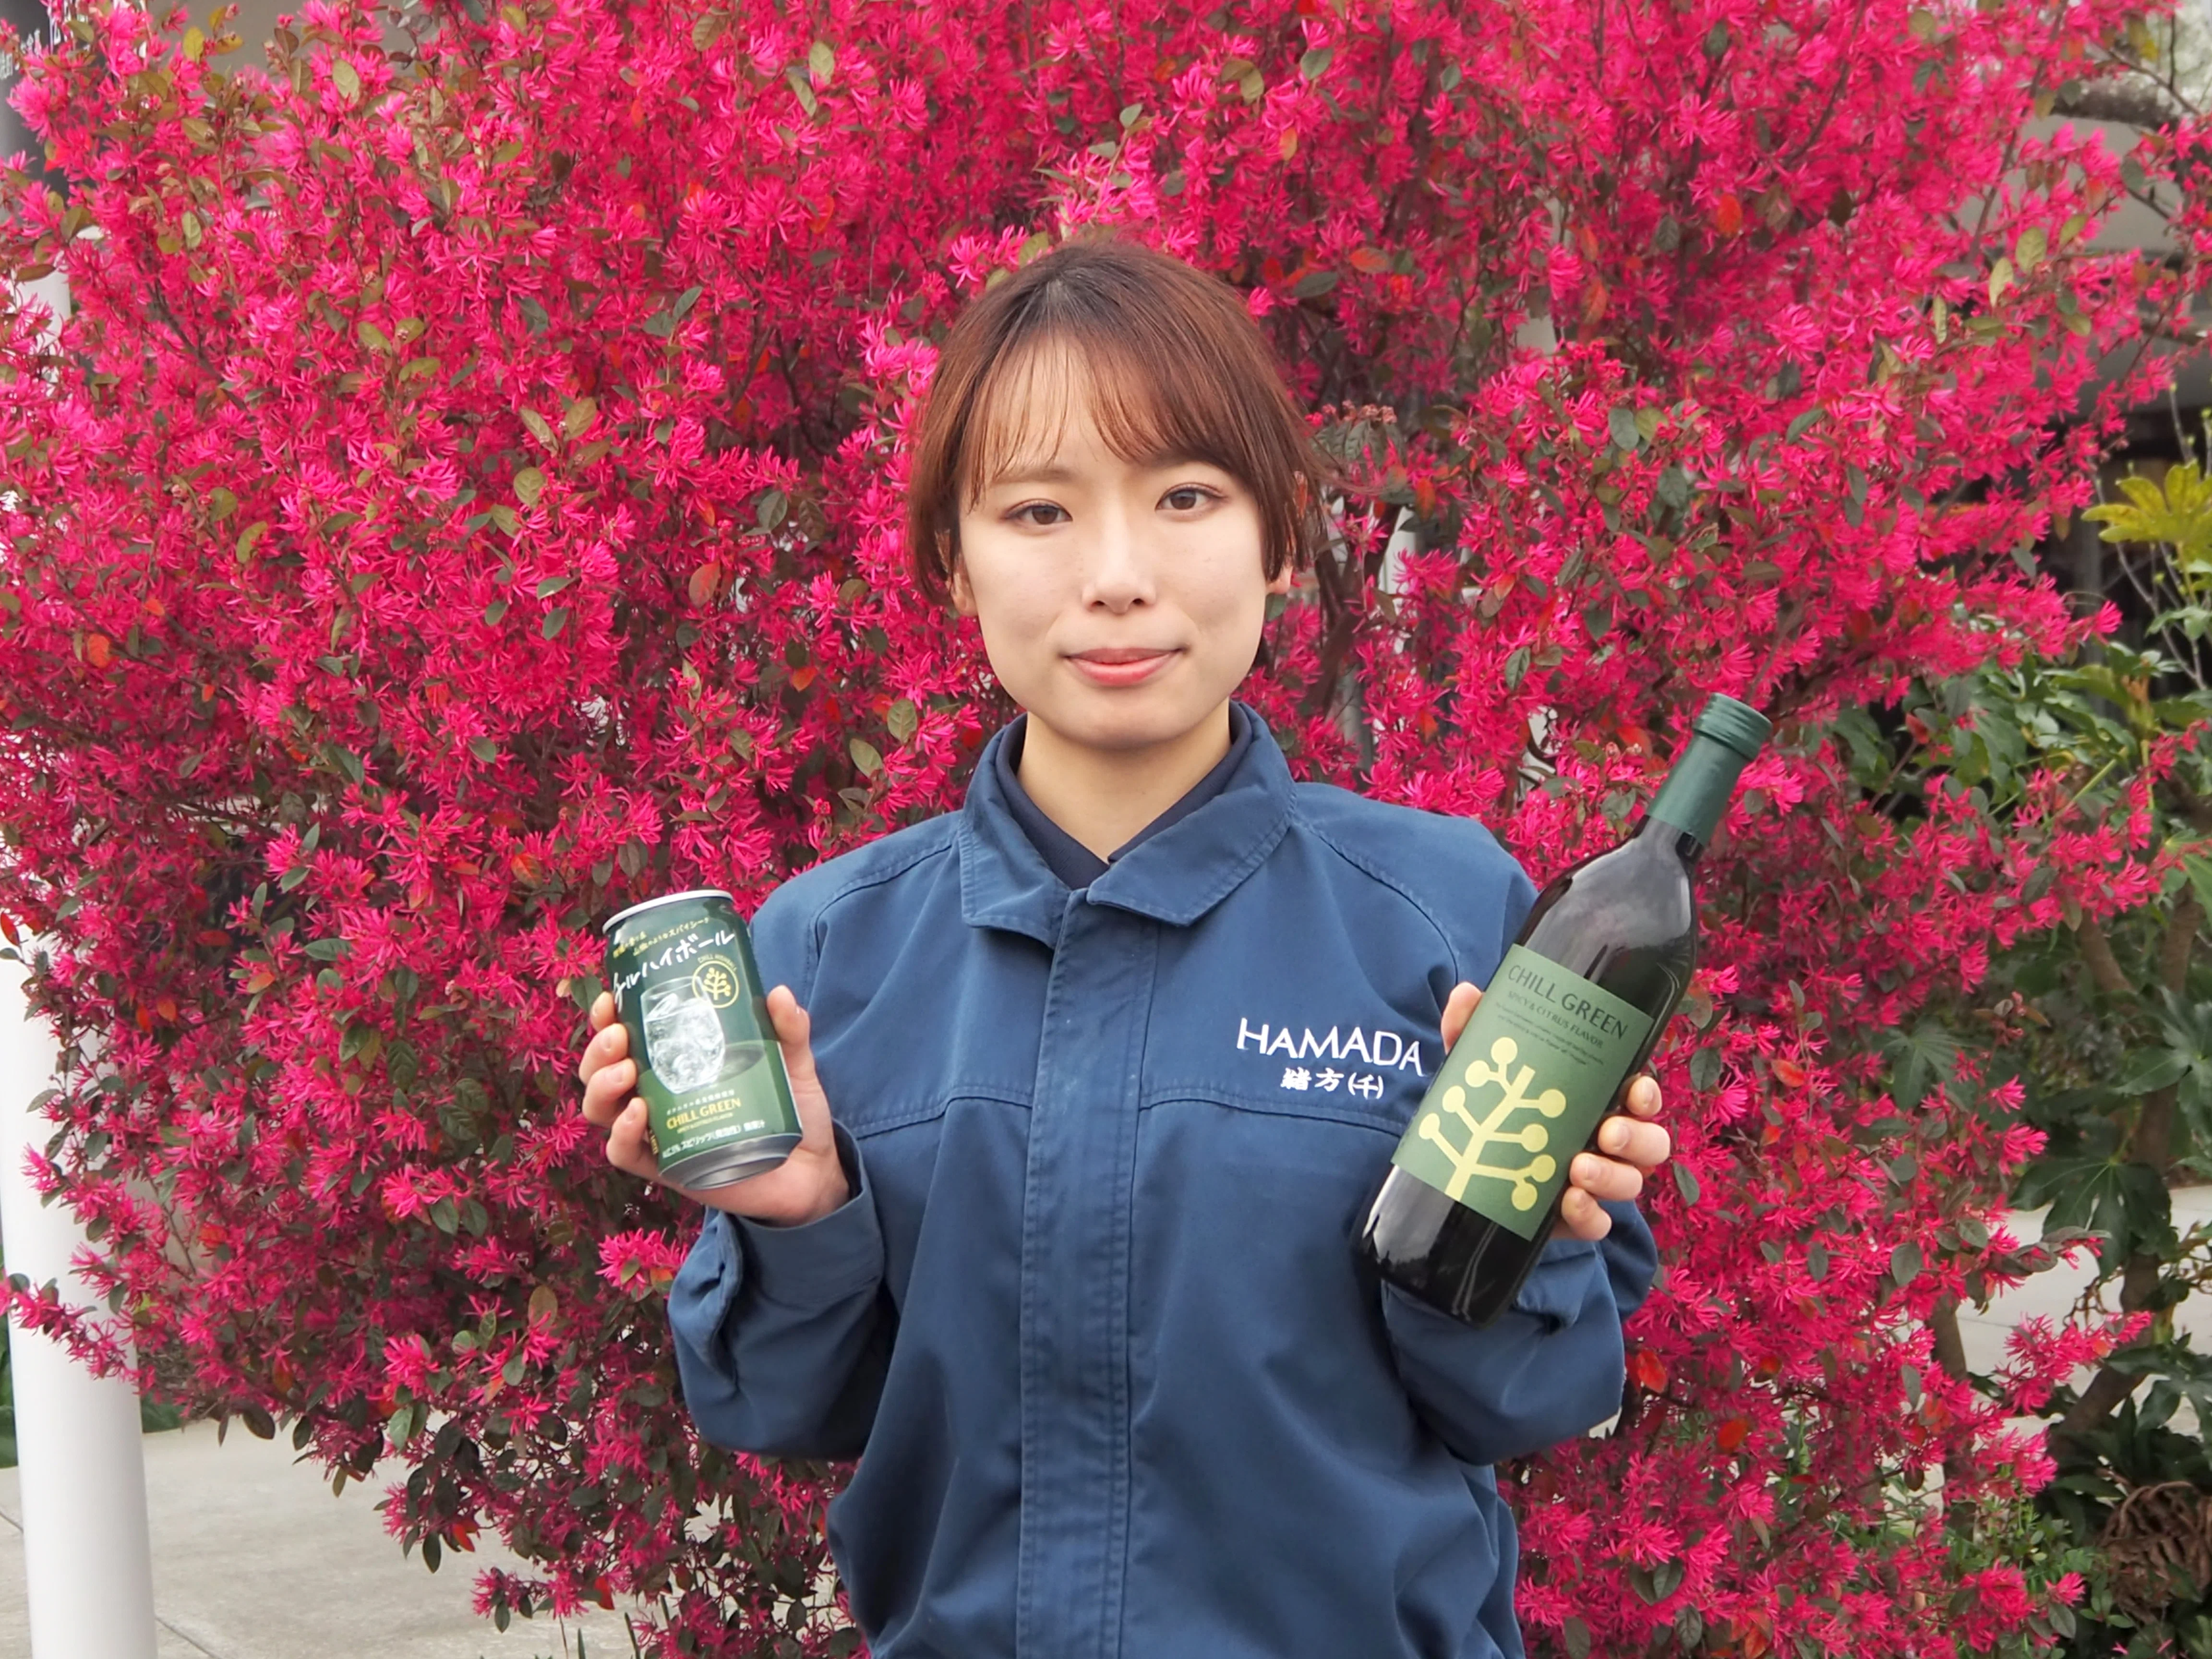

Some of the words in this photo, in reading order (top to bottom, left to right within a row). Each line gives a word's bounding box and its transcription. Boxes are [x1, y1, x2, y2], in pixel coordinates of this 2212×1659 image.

[1508, 964, 1556, 1003] CHILL
[1562, 993, 1628, 1040] GREEN
[1537, 1006, 1569, 1029] CITRUS
[1570, 1024, 1604, 1049] FLAVOR
[1236, 1017, 1426, 1077] HAMADA
[666, 1109, 699, 1130] CHILL
[699, 1097, 742, 1118] GREEN
